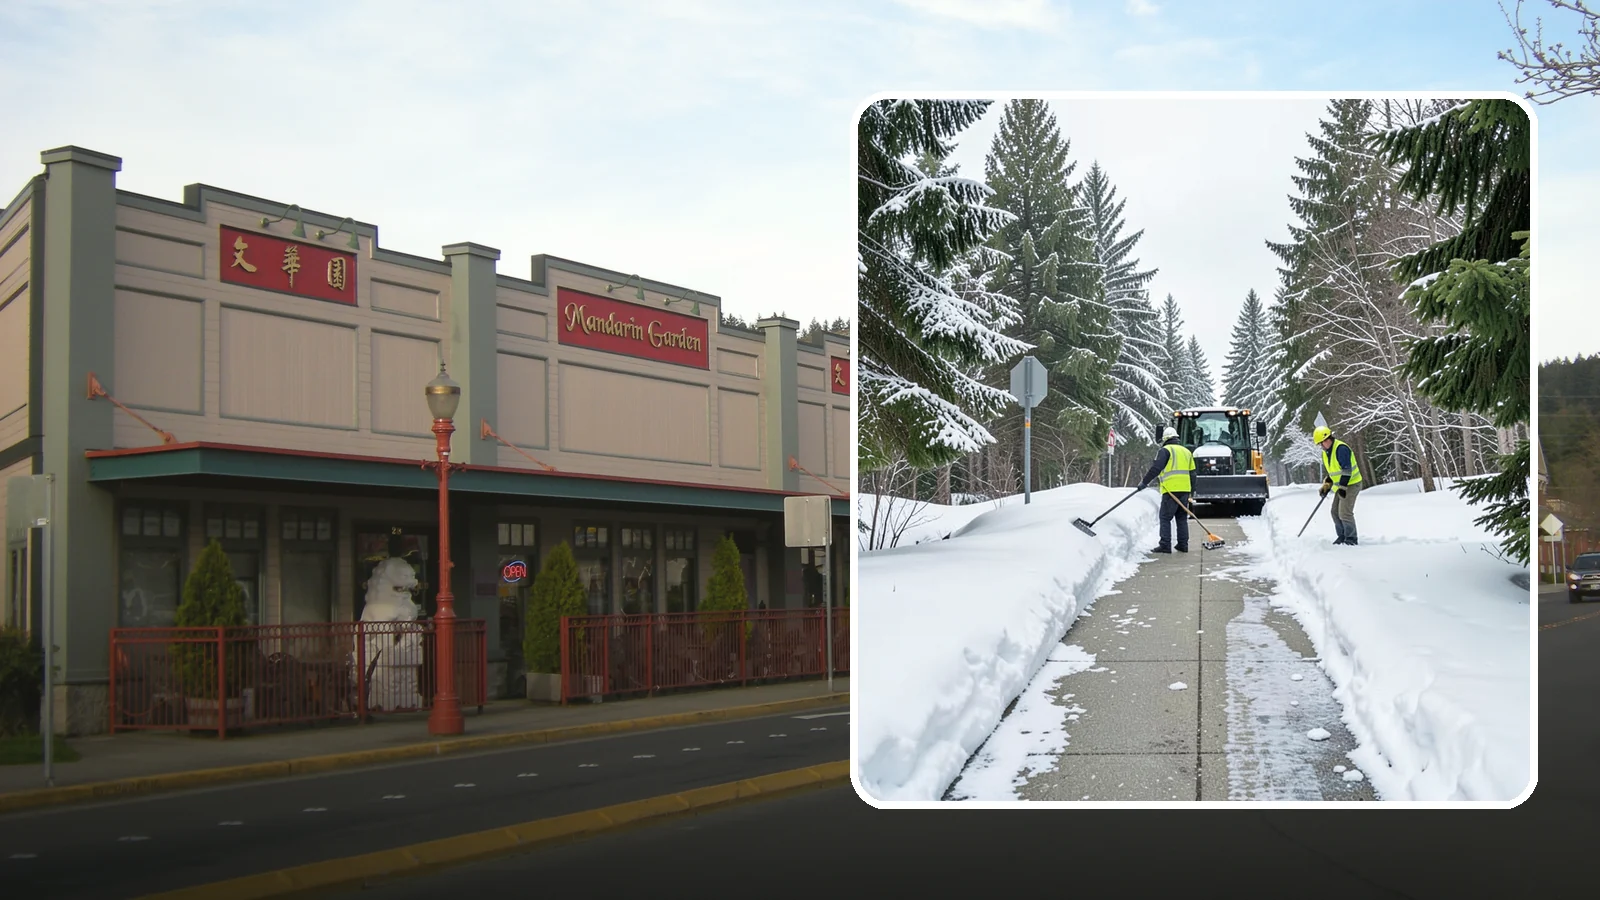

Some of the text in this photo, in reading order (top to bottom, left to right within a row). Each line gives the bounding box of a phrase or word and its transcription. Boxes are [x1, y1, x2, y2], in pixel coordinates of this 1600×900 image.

[230, 235, 346, 291] 文華園
[564, 302, 702, 352] Mandarin Garden
[503, 565, 527, 578] OPEN
